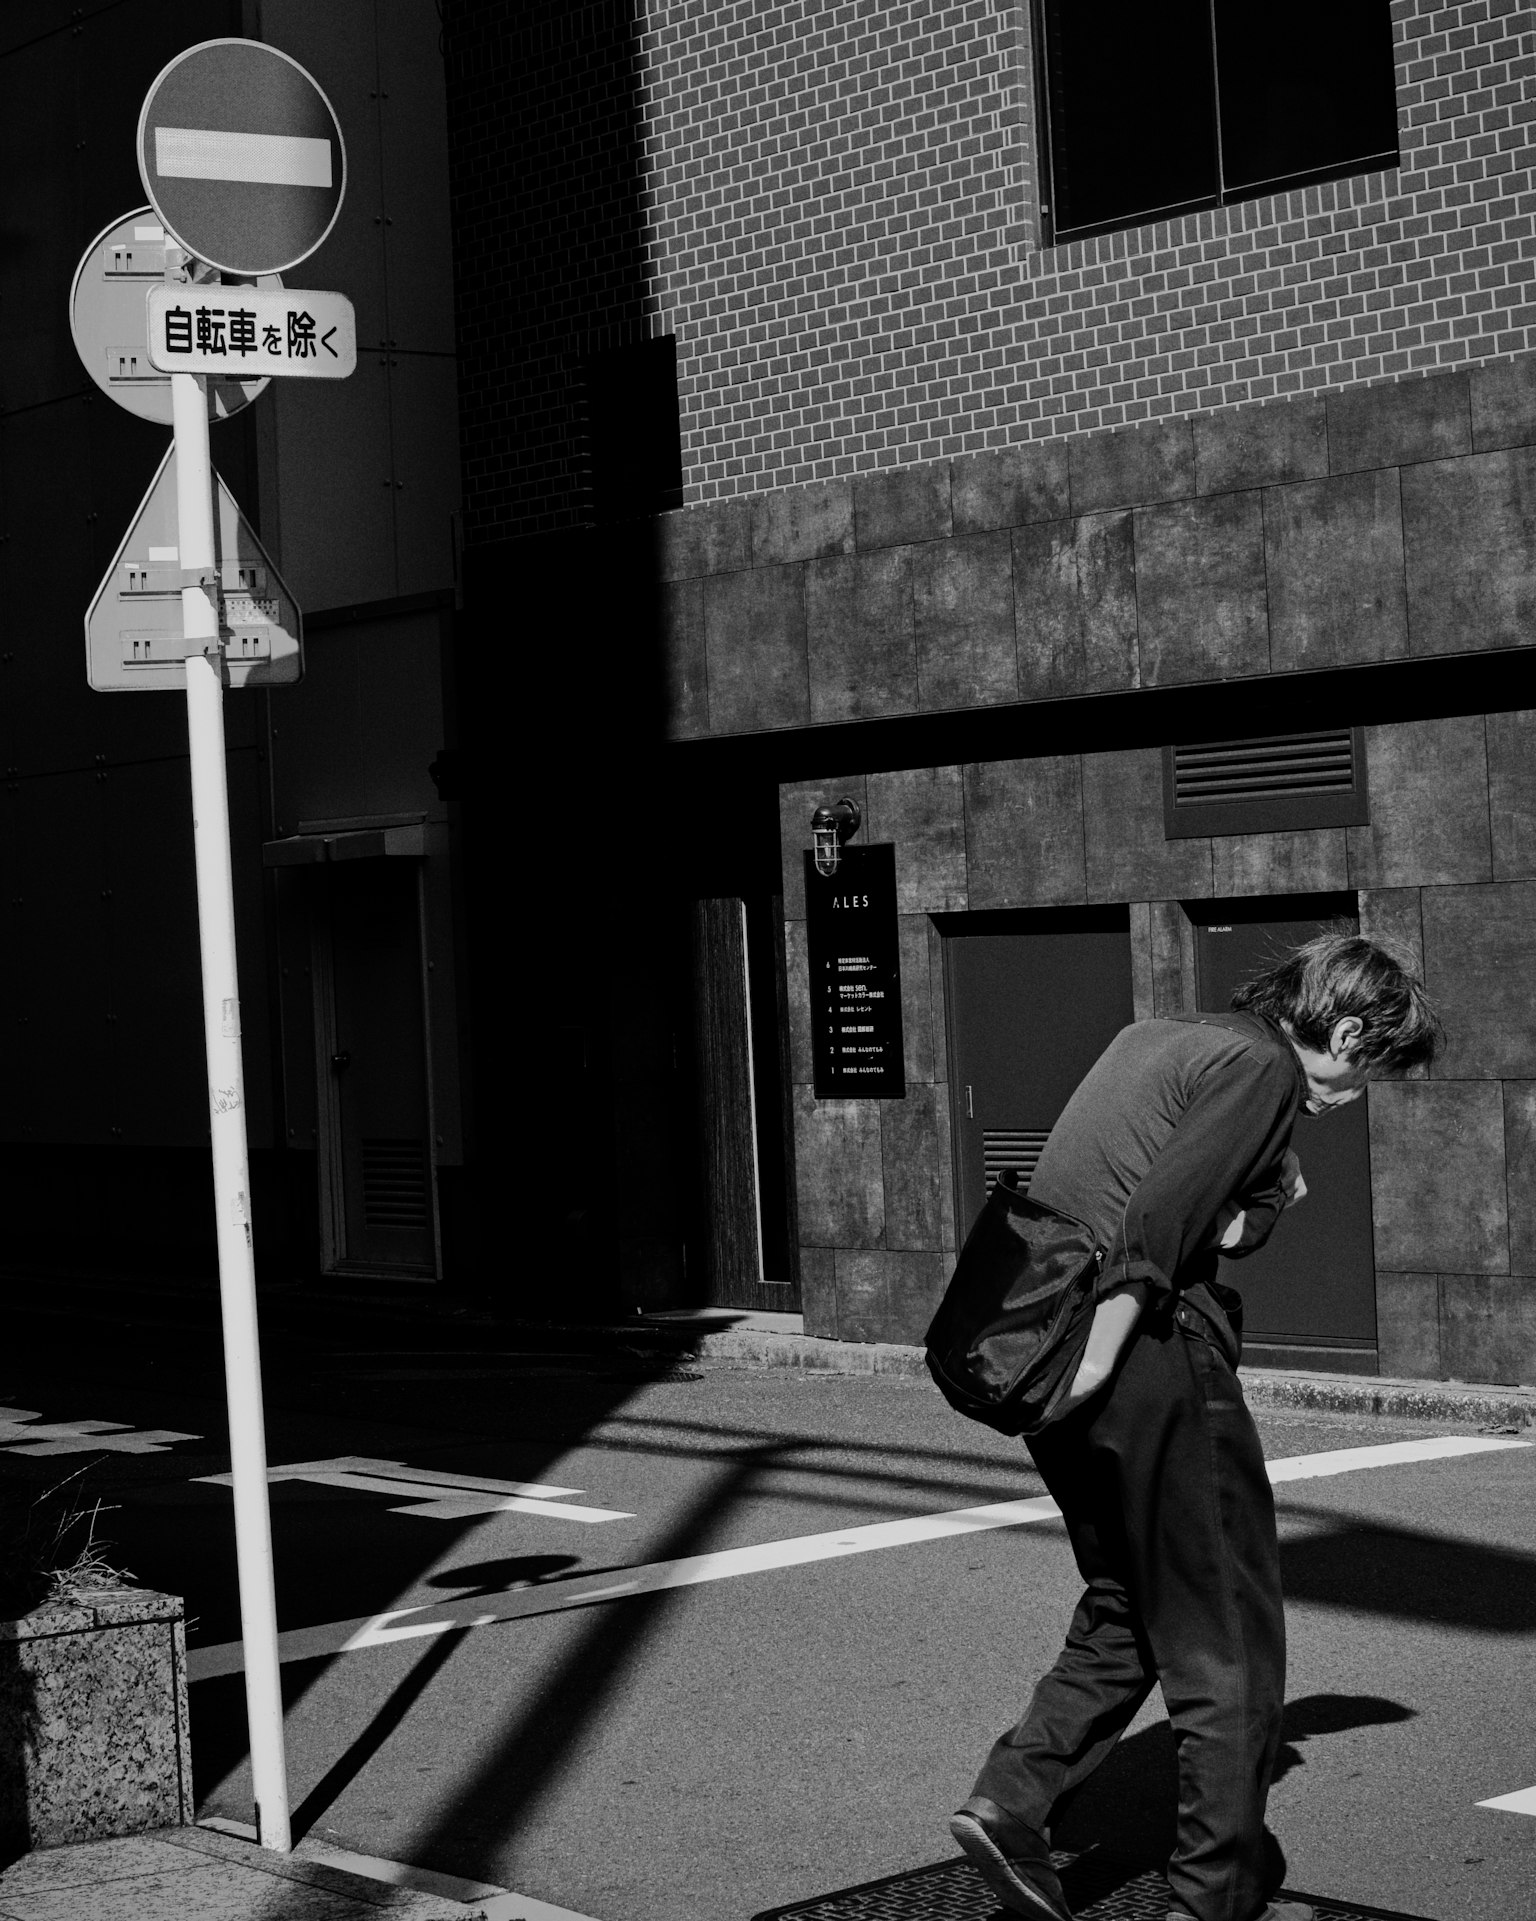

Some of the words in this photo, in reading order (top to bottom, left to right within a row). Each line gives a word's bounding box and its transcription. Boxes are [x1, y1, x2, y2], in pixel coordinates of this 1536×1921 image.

[165, 304, 339, 358] 自転車を除く
[832, 894, 869, 909] ALES
[827, 985, 832, 993] 5
[829, 1026, 834, 1034] 3
[829, 1046, 835, 1054] 2
